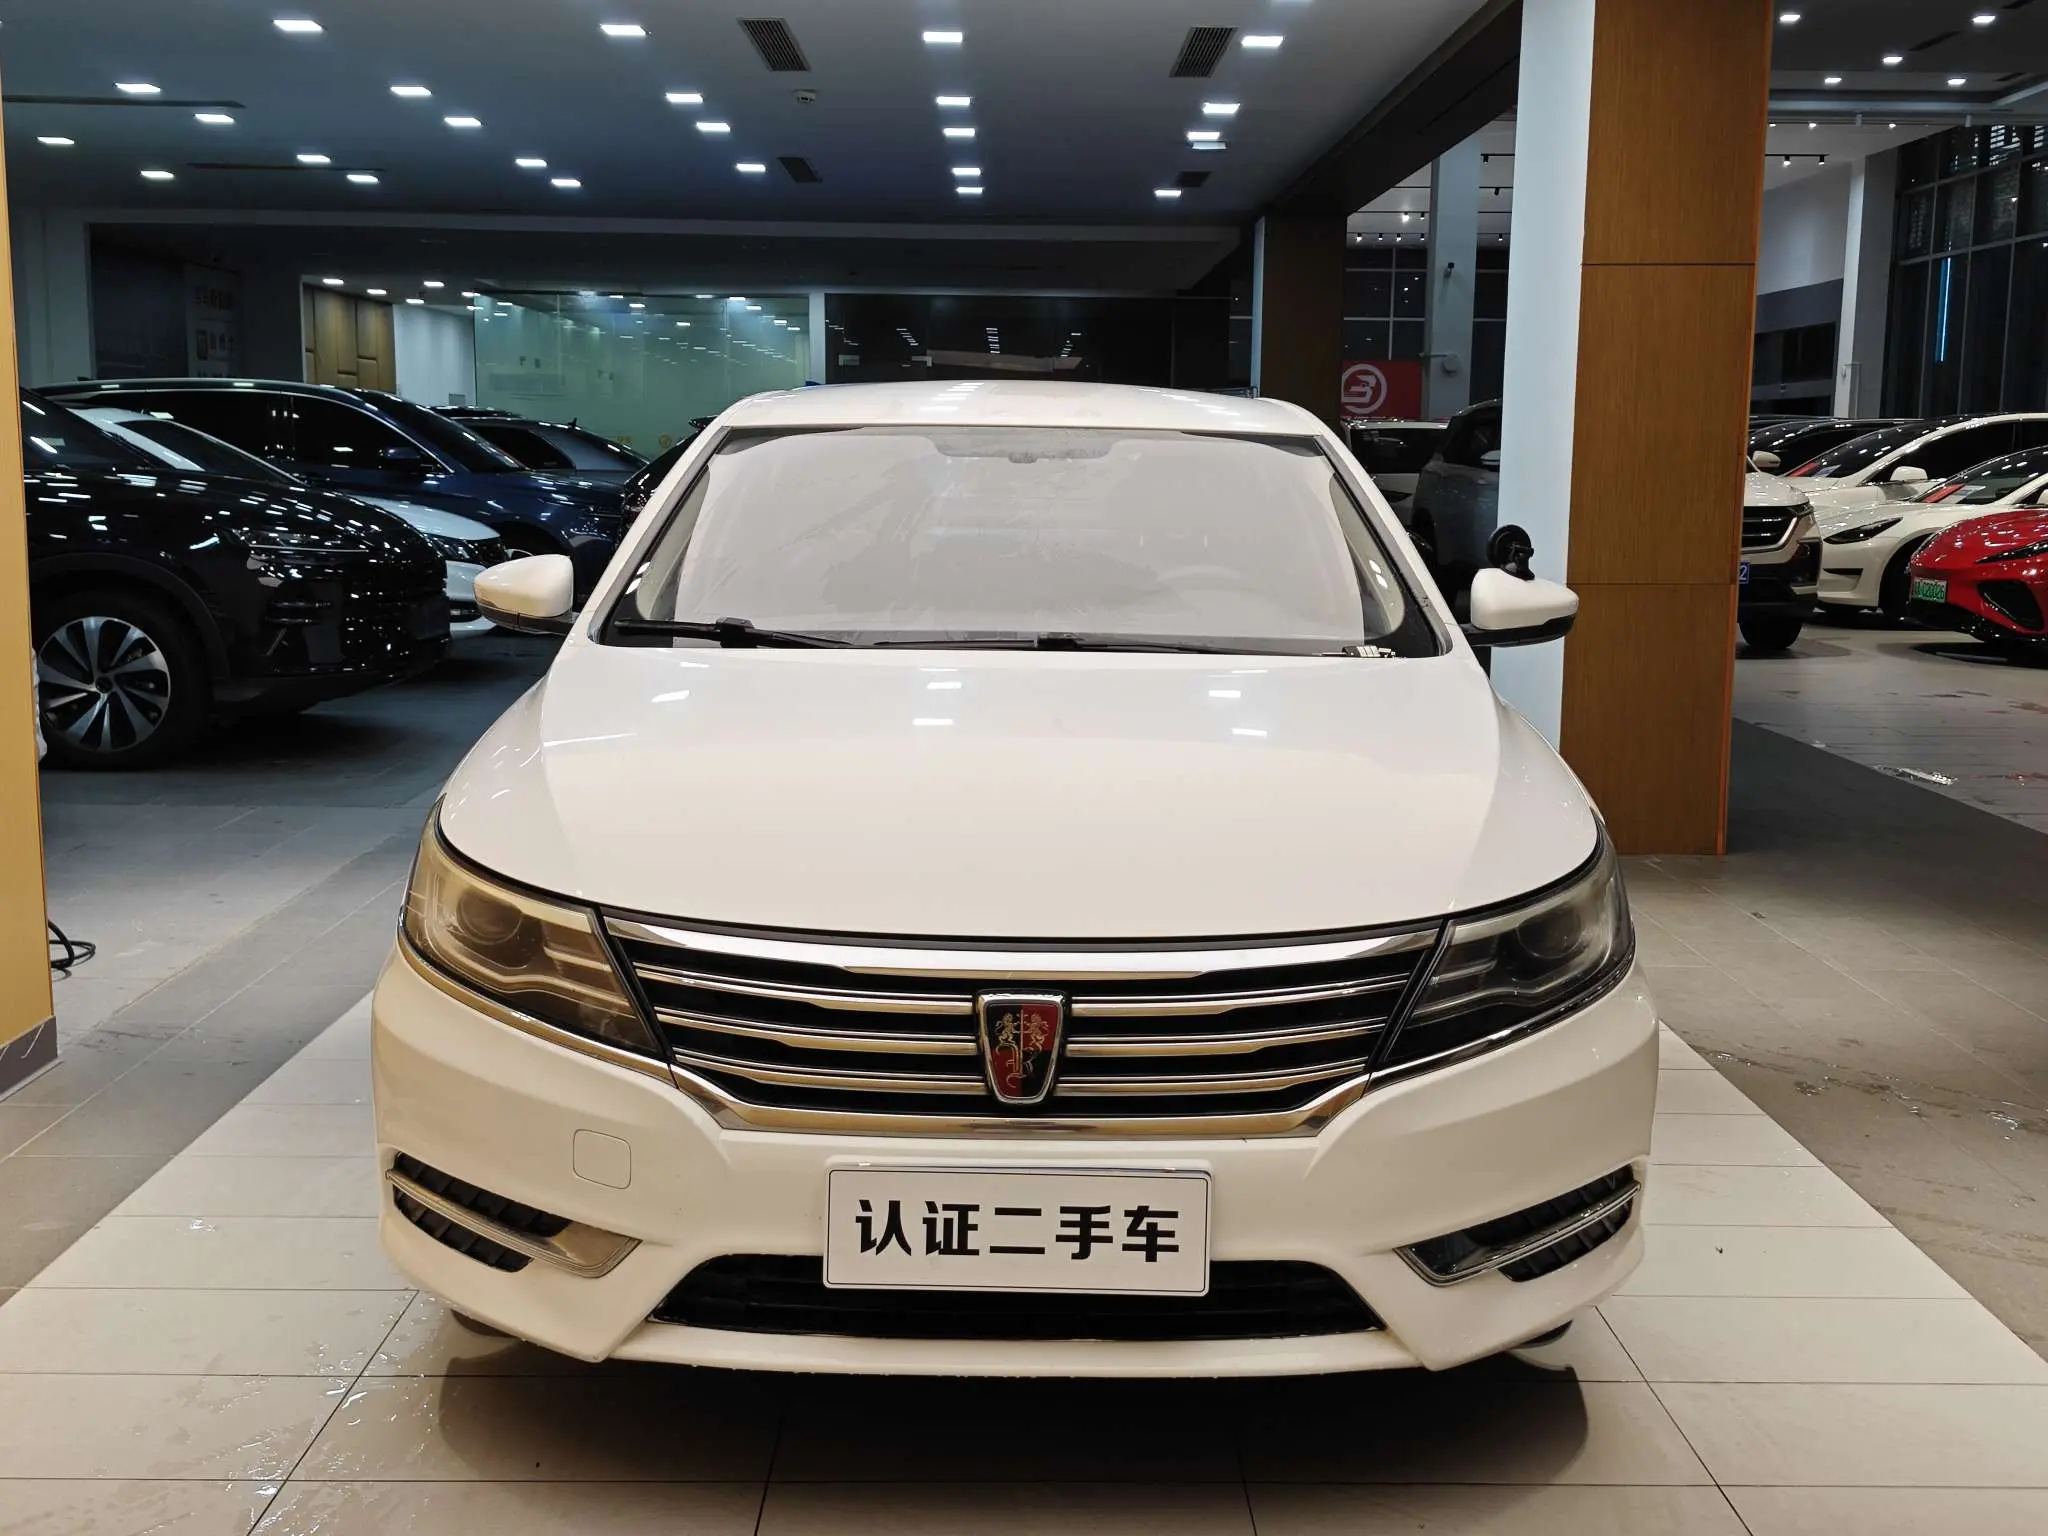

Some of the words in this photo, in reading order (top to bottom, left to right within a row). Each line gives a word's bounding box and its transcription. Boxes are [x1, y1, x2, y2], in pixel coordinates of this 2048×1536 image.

[856, 1200, 1179, 1262] 认证二手车
